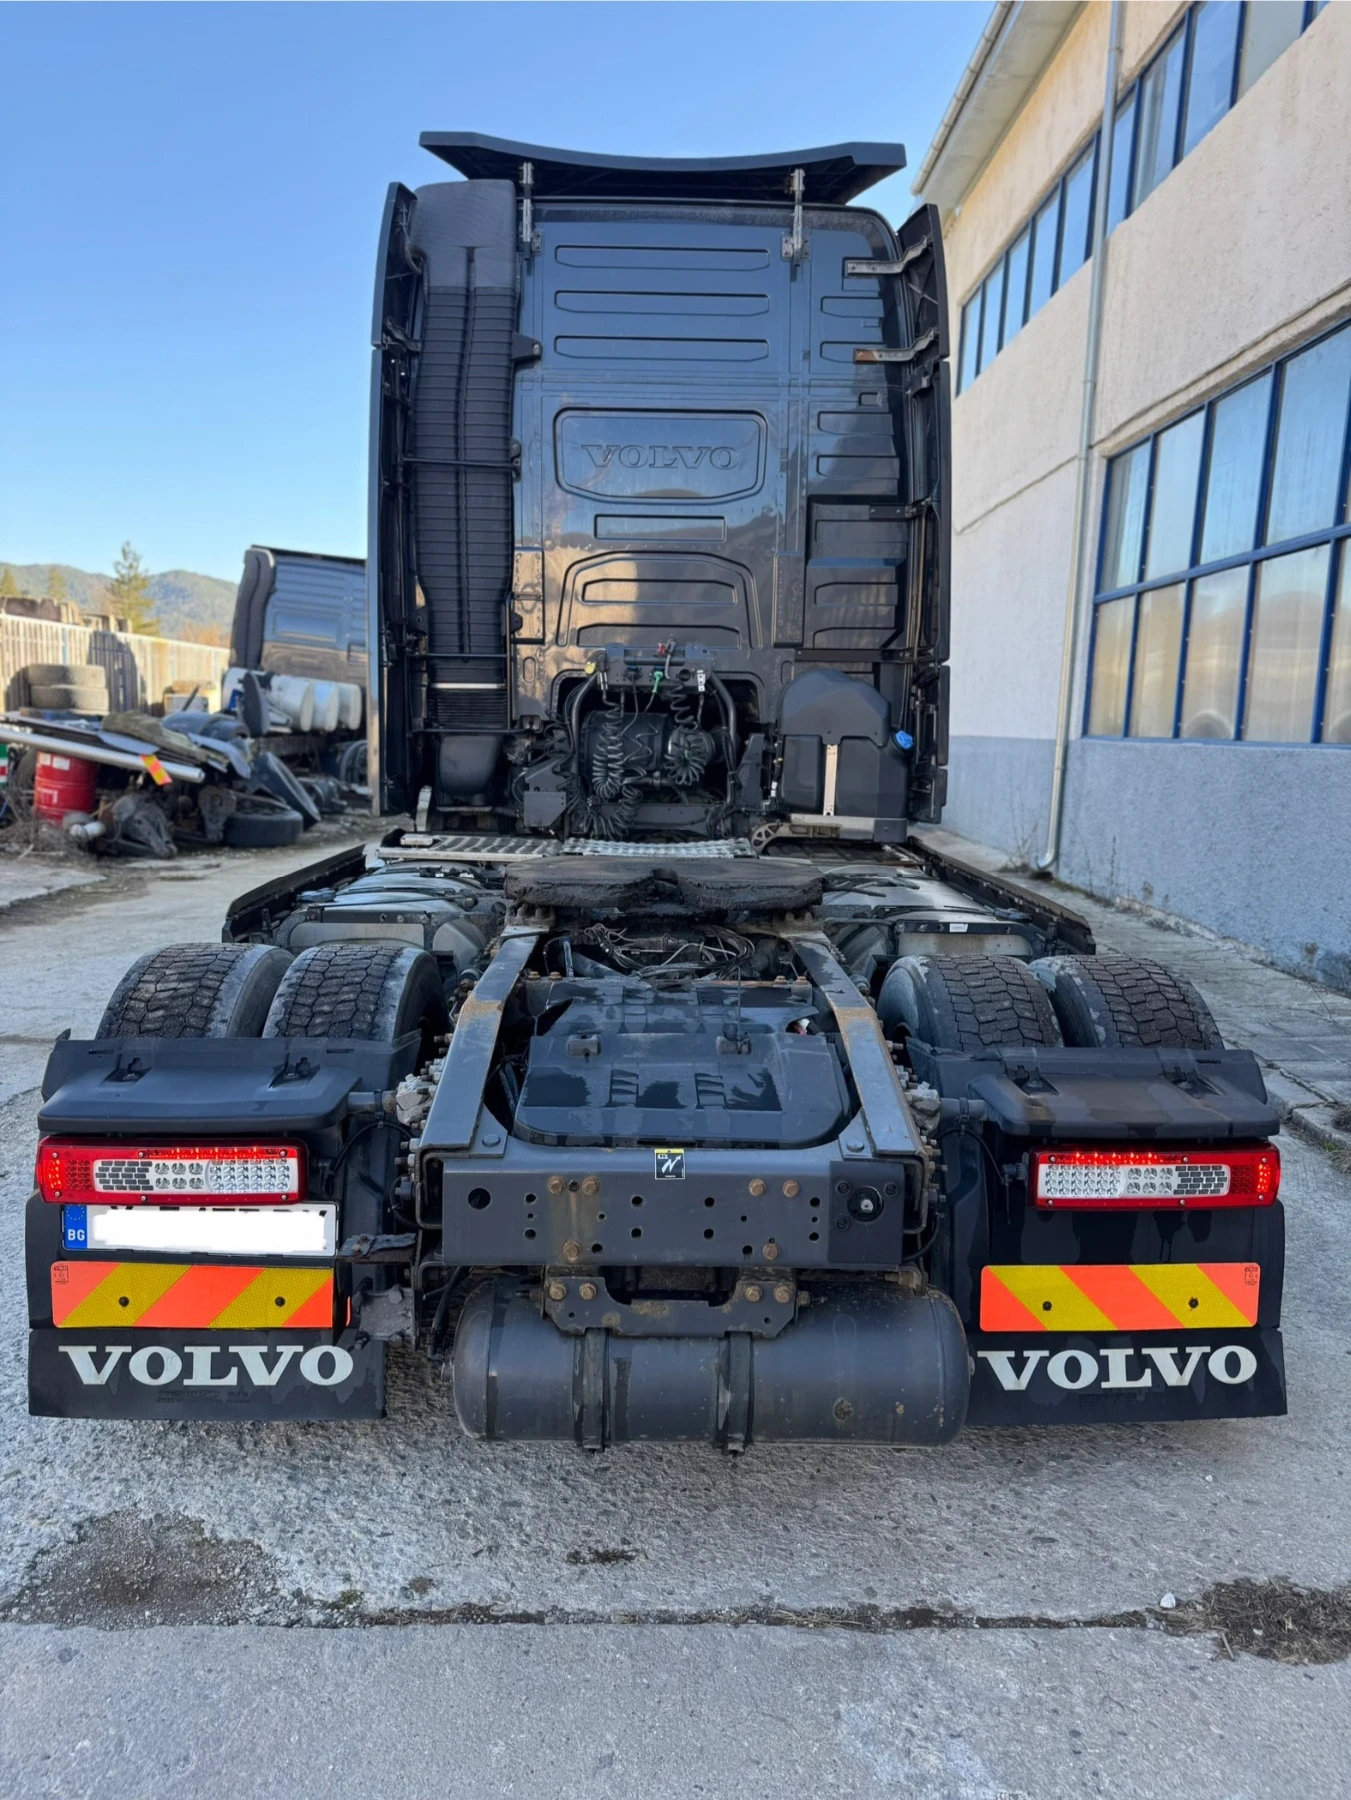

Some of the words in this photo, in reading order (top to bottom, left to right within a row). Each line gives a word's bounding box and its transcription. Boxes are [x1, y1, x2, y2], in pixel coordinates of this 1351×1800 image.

[581, 444, 740, 471] VOLVO
[67, 1228, 86, 1242] BG
[57, 1345, 354, 1387] VOLVO
[976, 1344, 1258, 1391] VOLVO
